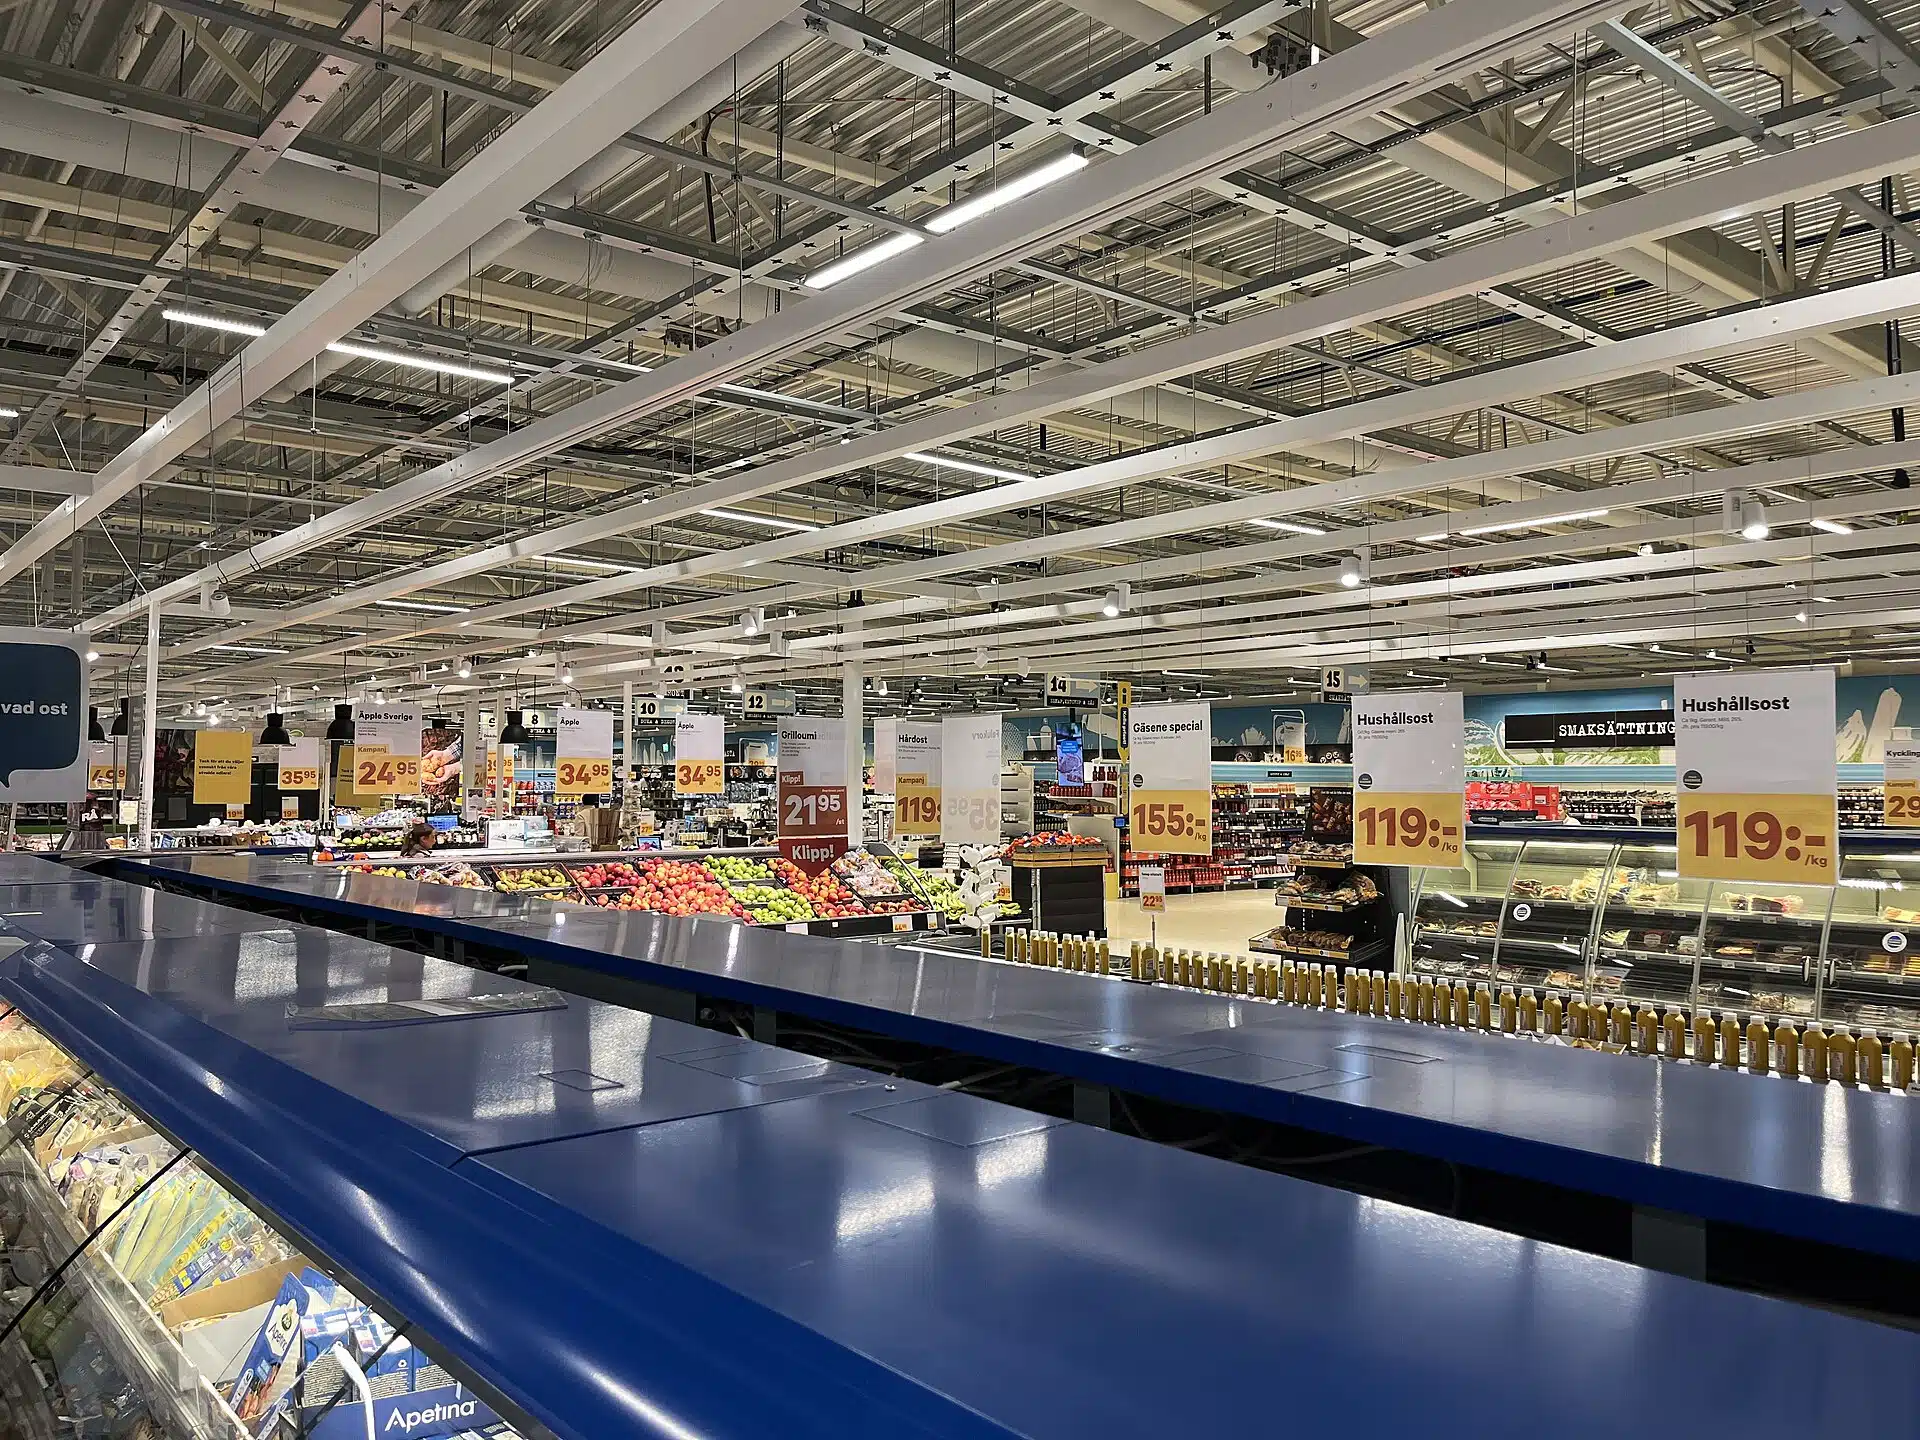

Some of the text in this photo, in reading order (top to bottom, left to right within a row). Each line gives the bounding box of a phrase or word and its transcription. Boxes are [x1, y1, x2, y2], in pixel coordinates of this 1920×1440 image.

[1050, 675, 1067, 692] 14
[1326, 670, 1340, 688] 15
[0, 700, 68, 715] vad ost
[640, 702, 656, 714] 10
[748, 694, 764, 708] 12
[1682, 696, 1790, 712] Hushållsost
[359, 710, 413, 721] Äpple Sverige
[532, 714, 538, 724] 8
[560, 717, 580, 726] Äpple
[1357, 712, 1434, 726] Hushållsost
[678, 721, 694, 729] Äpple
[1133, 720, 1203, 734] Gäsene special
[1558, 721, 1676, 737] SMAKSÄTTNING
[781, 731, 817, 740] Grilloumi
[898, 734, 928, 743] Hårdost
[782, 775, 800, 784] Klipp!
[82, 808, 98, 821] RÅ
[1133, 804, 1206, 836] 155:-
[1358, 807, 1457, 847] 119:-
[1195, 833, 1206, 841] /kg
[1684, 810, 1826, 861] 119:-
[792, 844, 834, 862] Klipp!
[1442, 842, 1458, 853] /kg
[1804, 855, 1827, 868] /kg
[384, 1400, 477, 1433] Apetina
